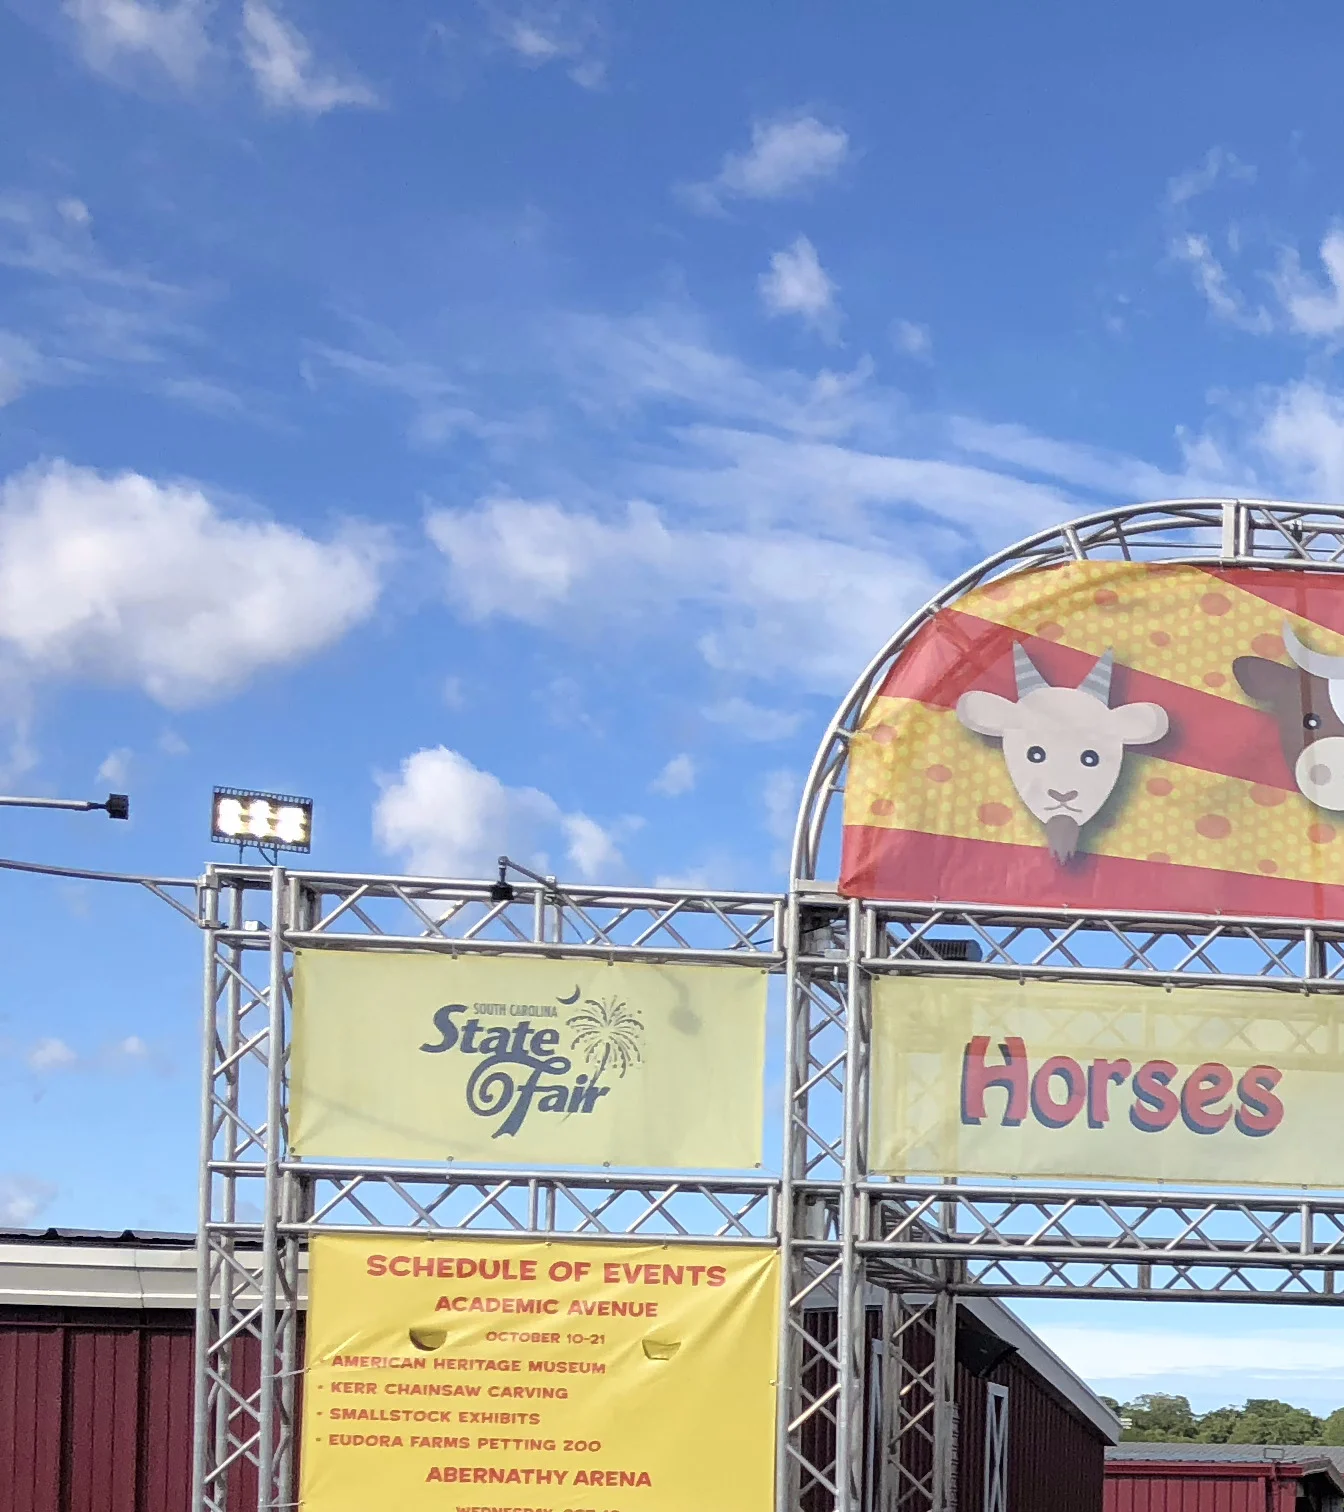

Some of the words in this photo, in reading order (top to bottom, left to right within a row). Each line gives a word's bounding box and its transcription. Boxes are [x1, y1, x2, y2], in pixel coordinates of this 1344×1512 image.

[473, 1002, 506, 1016] SOUTH
[510, 1004, 558, 1018] CAROLINA
[419, 1003, 560, 1056] State
[466, 1053, 611, 1139] Fair
[960, 1035, 1286, 1138] Horses
[367, 1255, 537, 1282] SCHEDULE
[548, 1261, 592, 1283] OF
[603, 1262, 728, 1287] EVENTS
[435, 1296, 560, 1315] ACADEMIC
[567, 1299, 658, 1318] AVENUE
[484, 1331, 561, 1344] OCTOBER
[567, 1333, 607, 1345] 10-21
[331, 1355, 427, 1369] AMERICAN
[433, 1358, 521, 1373] HERITAGE
[528, 1360, 607, 1374] MUSEUM
[330, 1381, 378, 1395] KERR
[384, 1383, 481, 1397] CHAINSAW
[487, 1385, 569, 1400] CARVING
[329, 1407, 452, 1423] SMALLSTOCK
[458, 1411, 541, 1425] EXHIBITS
[328, 1434, 404, 1448] EUDORA
[410, 1435, 471, 1449] FARMS
[477, 1437, 557, 1452] PETTING
[563, 1439, 602, 1452] ZOO
[425, 1467, 568, 1485] ABERNATHY
[574, 1470, 652, 1487] ARENA
